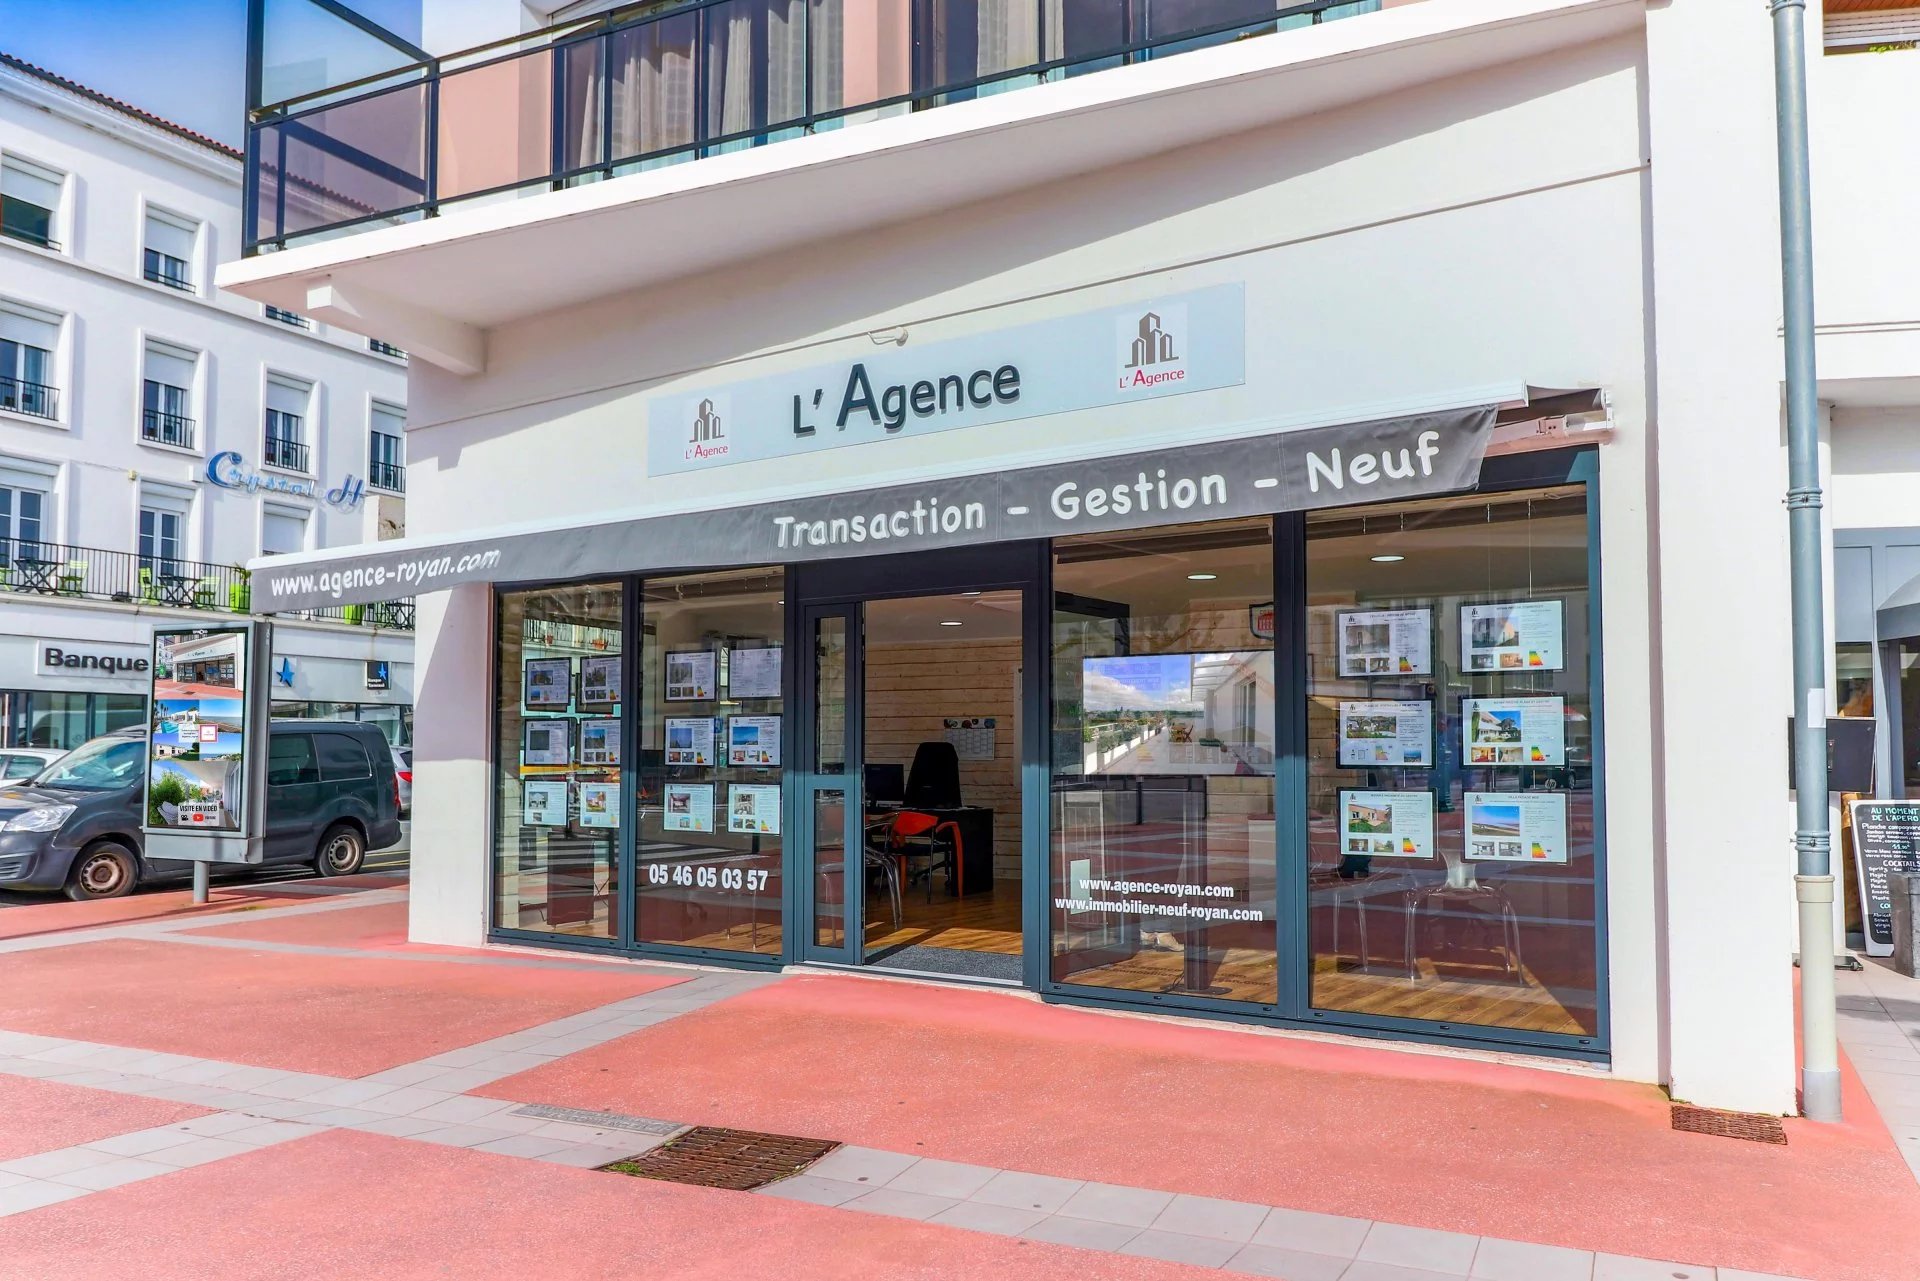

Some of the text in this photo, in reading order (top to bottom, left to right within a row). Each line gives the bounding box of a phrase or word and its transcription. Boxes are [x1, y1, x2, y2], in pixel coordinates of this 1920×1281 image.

[1133, 369, 1185, 387] Agence
[793, 363, 1021, 434] L' Agence
[694, 444, 729, 459] Agence
[206, 451, 315, 495] Crystal
[773, 497, 986, 548] Transaction
[1051, 469, 1228, 520] Gestion
[1307, 429, 1442, 494] Neuf
[271, 549, 502, 599] www.agence-royan.com
[45, 647, 149, 675] Banque
[1885, 807, 1919, 815] MOMENT
[1882, 860, 1920, 868] COCKTAILS
[649, 864, 769, 891] 05 46 05 03 57
[1079, 879, 1235, 898] www.agence-royan.com
[1055, 897, 1264, 922] www.immobilier-neuf-royan.com
